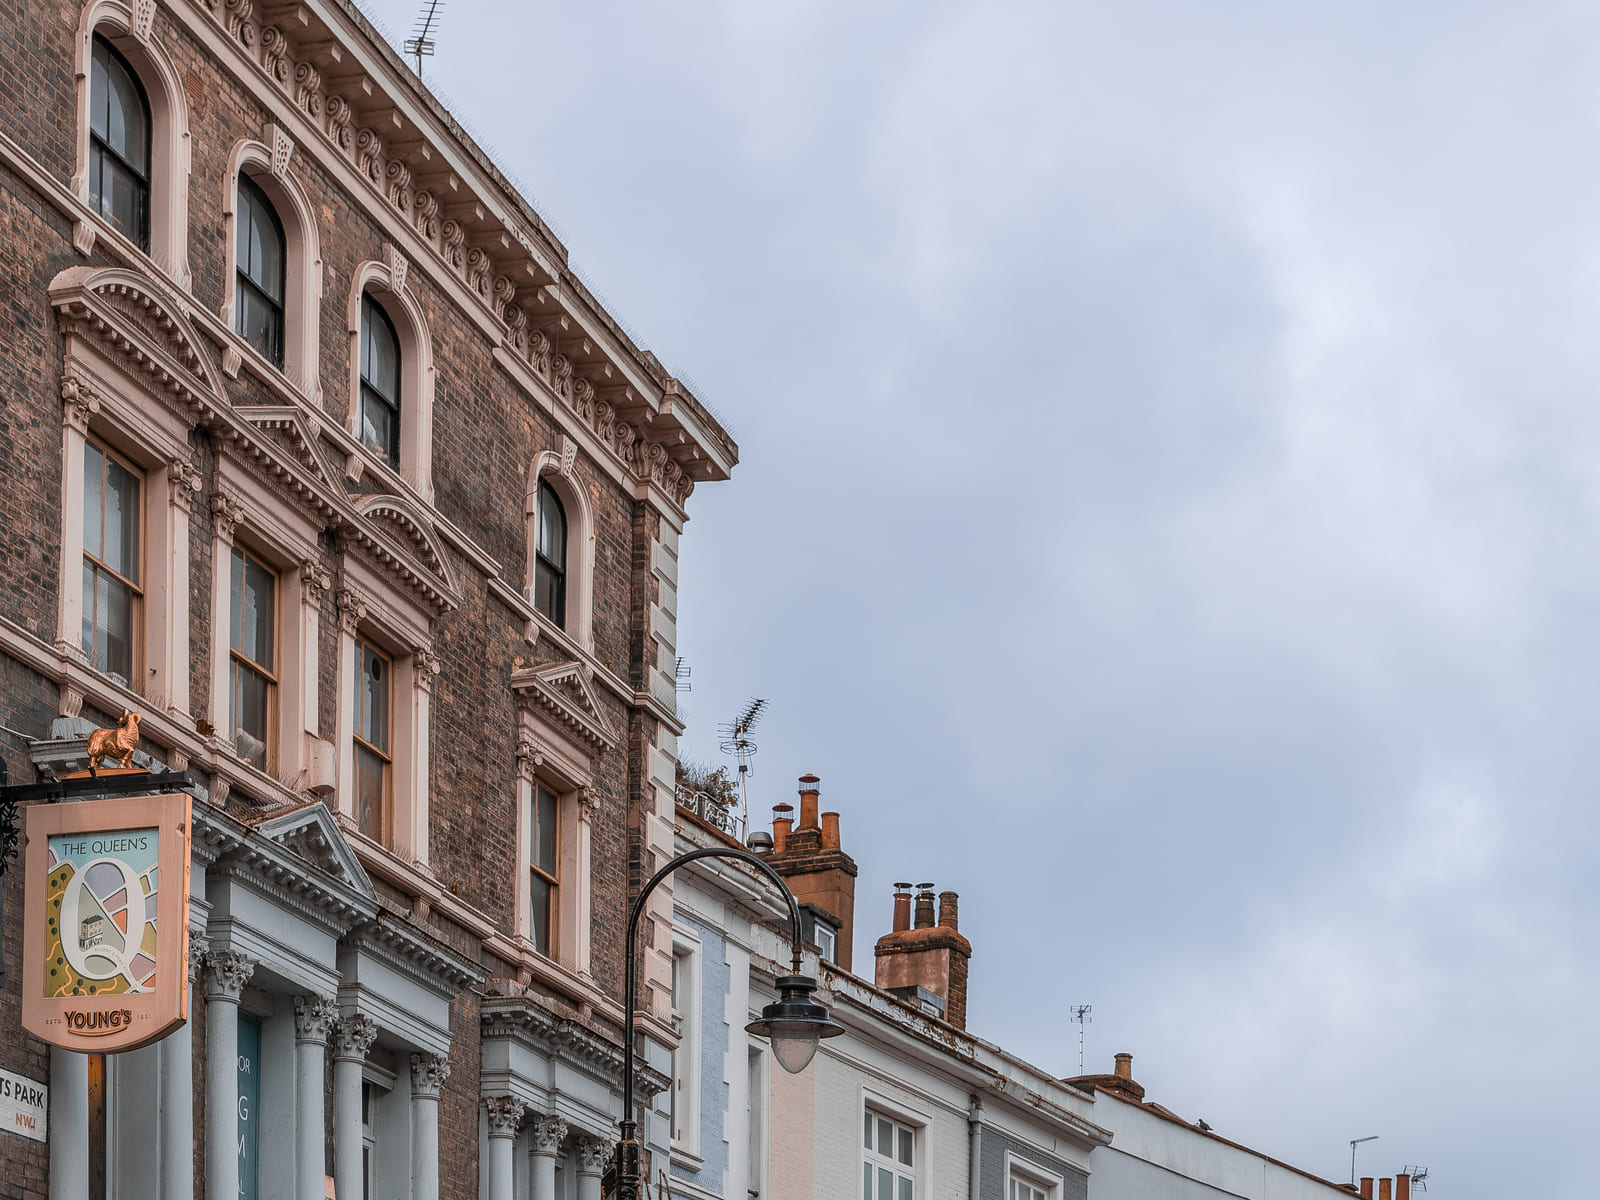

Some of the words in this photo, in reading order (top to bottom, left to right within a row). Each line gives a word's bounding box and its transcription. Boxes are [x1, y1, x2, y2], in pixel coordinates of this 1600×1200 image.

[62, 842, 87, 856] THE
[92, 837, 148, 854] QUEEN'S
[64, 1008, 132, 1029] YOUNG'S
[14, 1082, 44, 1109] PARK
